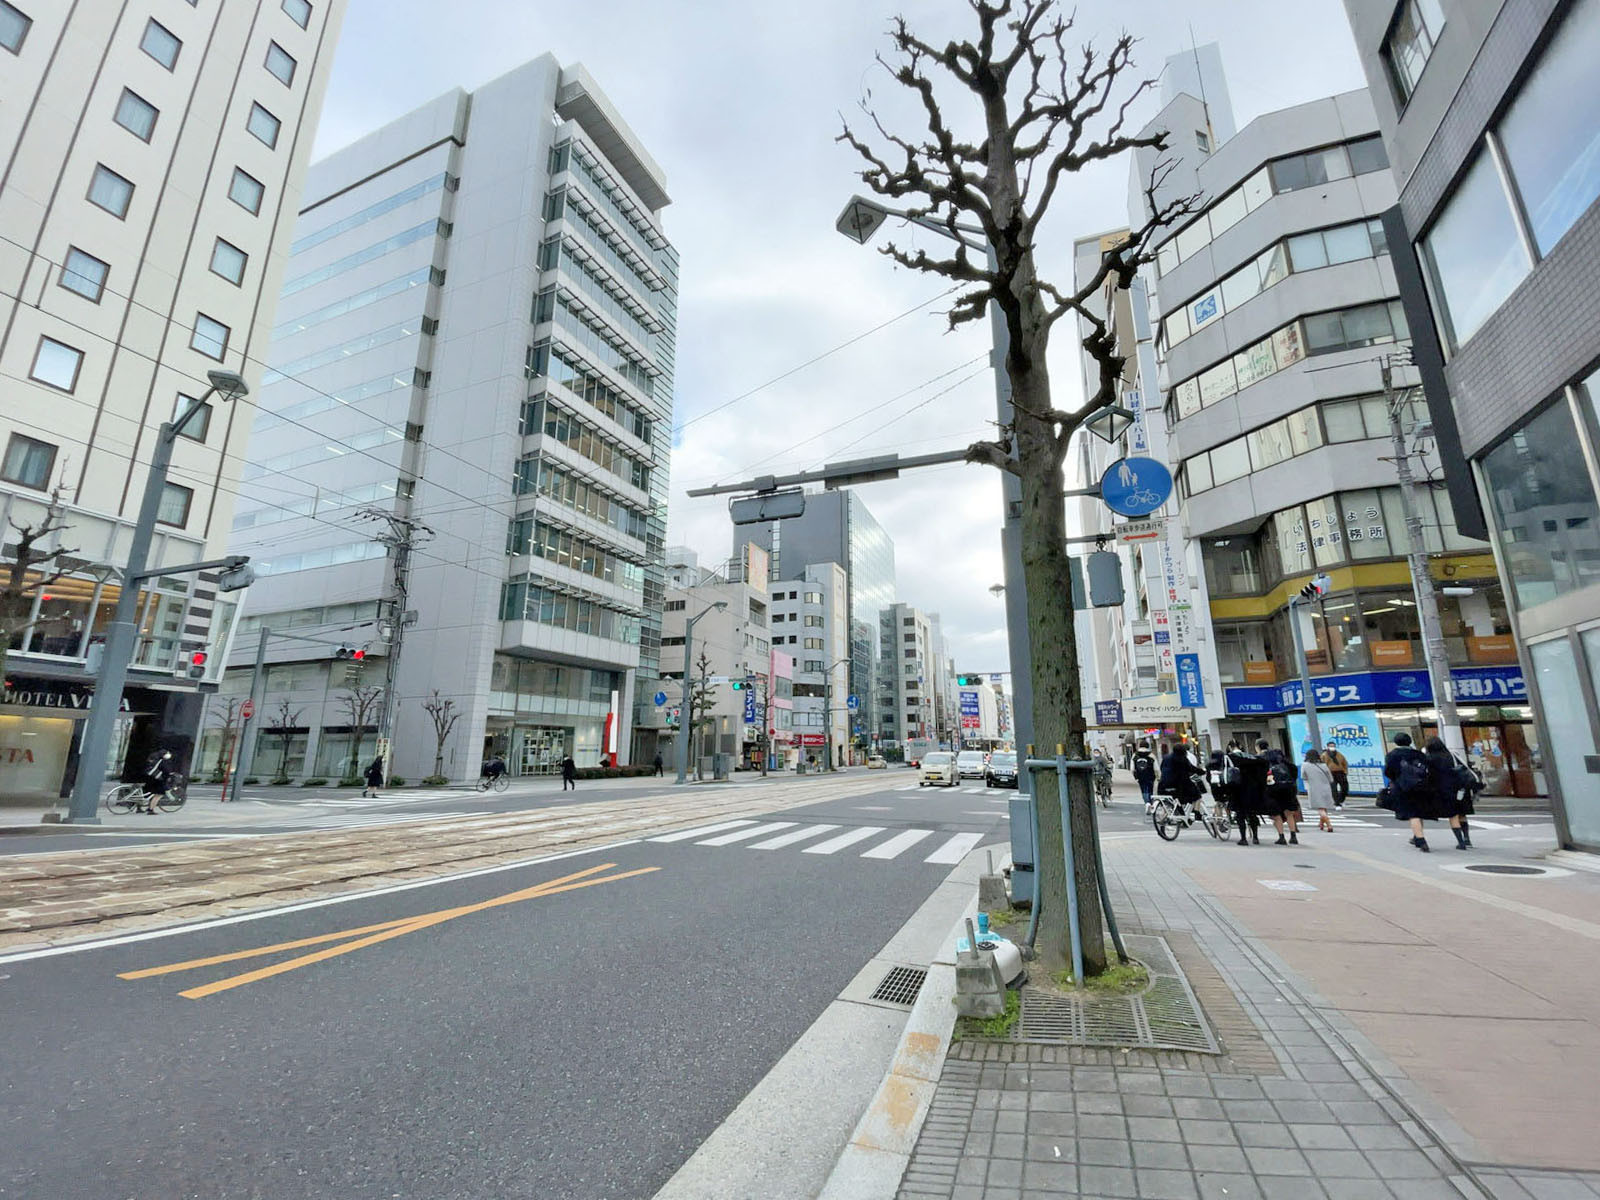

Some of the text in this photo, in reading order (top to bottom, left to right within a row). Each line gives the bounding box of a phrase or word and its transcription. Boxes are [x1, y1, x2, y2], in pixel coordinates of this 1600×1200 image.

[1293, 507, 1378, 535] いちじょう
[1296, 526, 1384, 552] 法律事務所
[4, 690, 130, 711] HOTEL VIA
